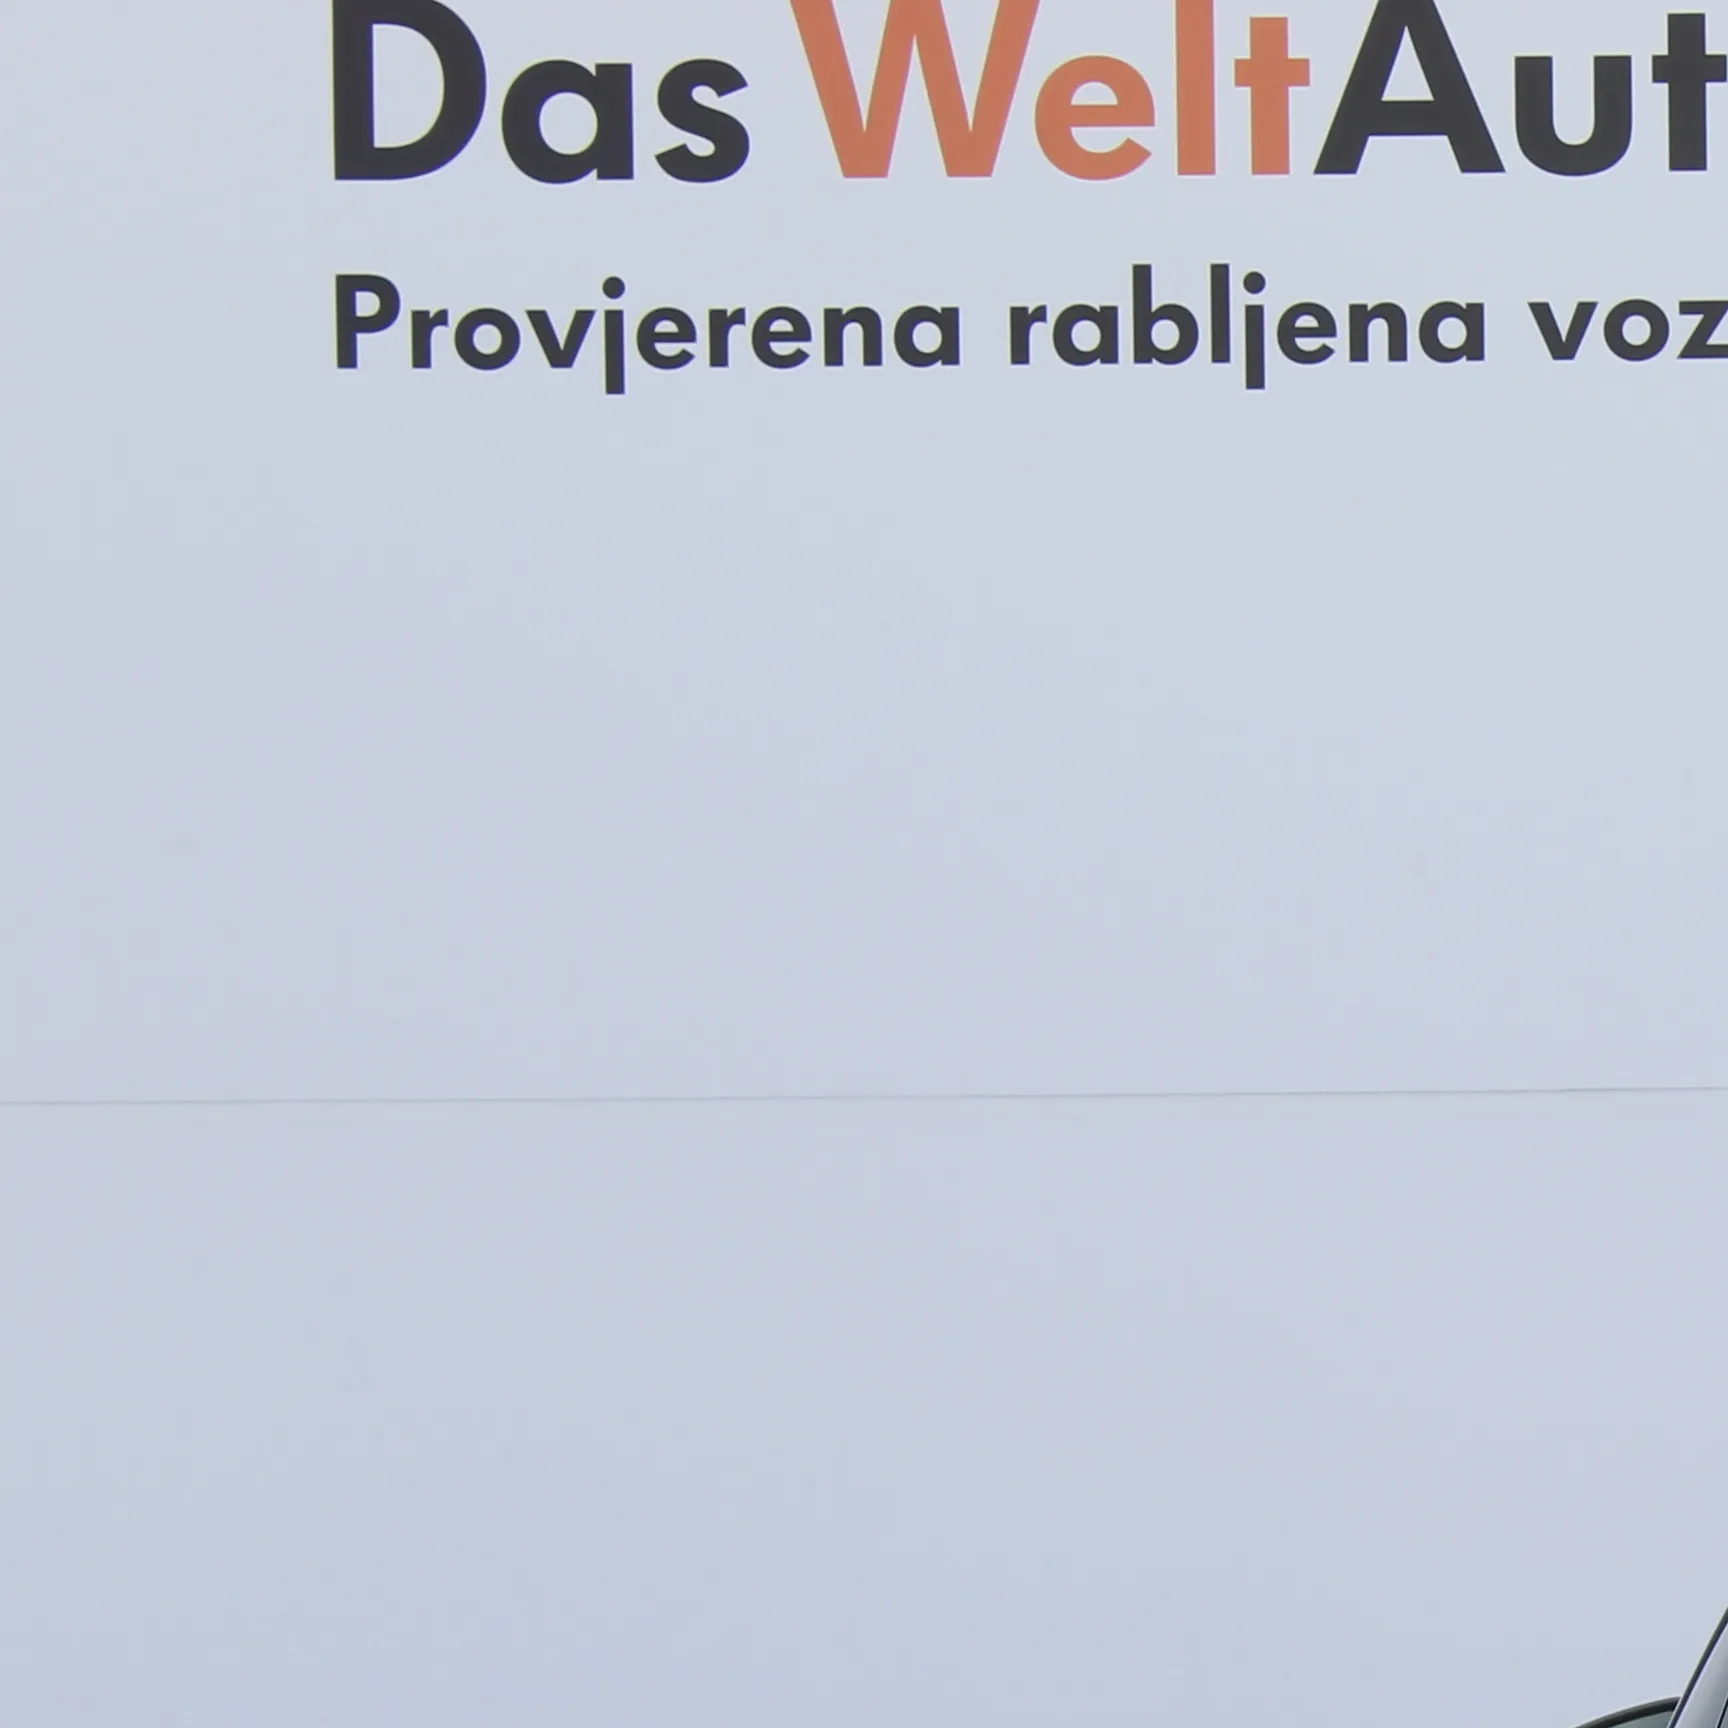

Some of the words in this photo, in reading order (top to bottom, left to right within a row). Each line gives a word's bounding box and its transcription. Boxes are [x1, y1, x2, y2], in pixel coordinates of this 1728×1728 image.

[331, 0, 751, 185] Das
[334, 273, 961, 396] Provjerena
[1009, 262, 1486, 391] rabljena
